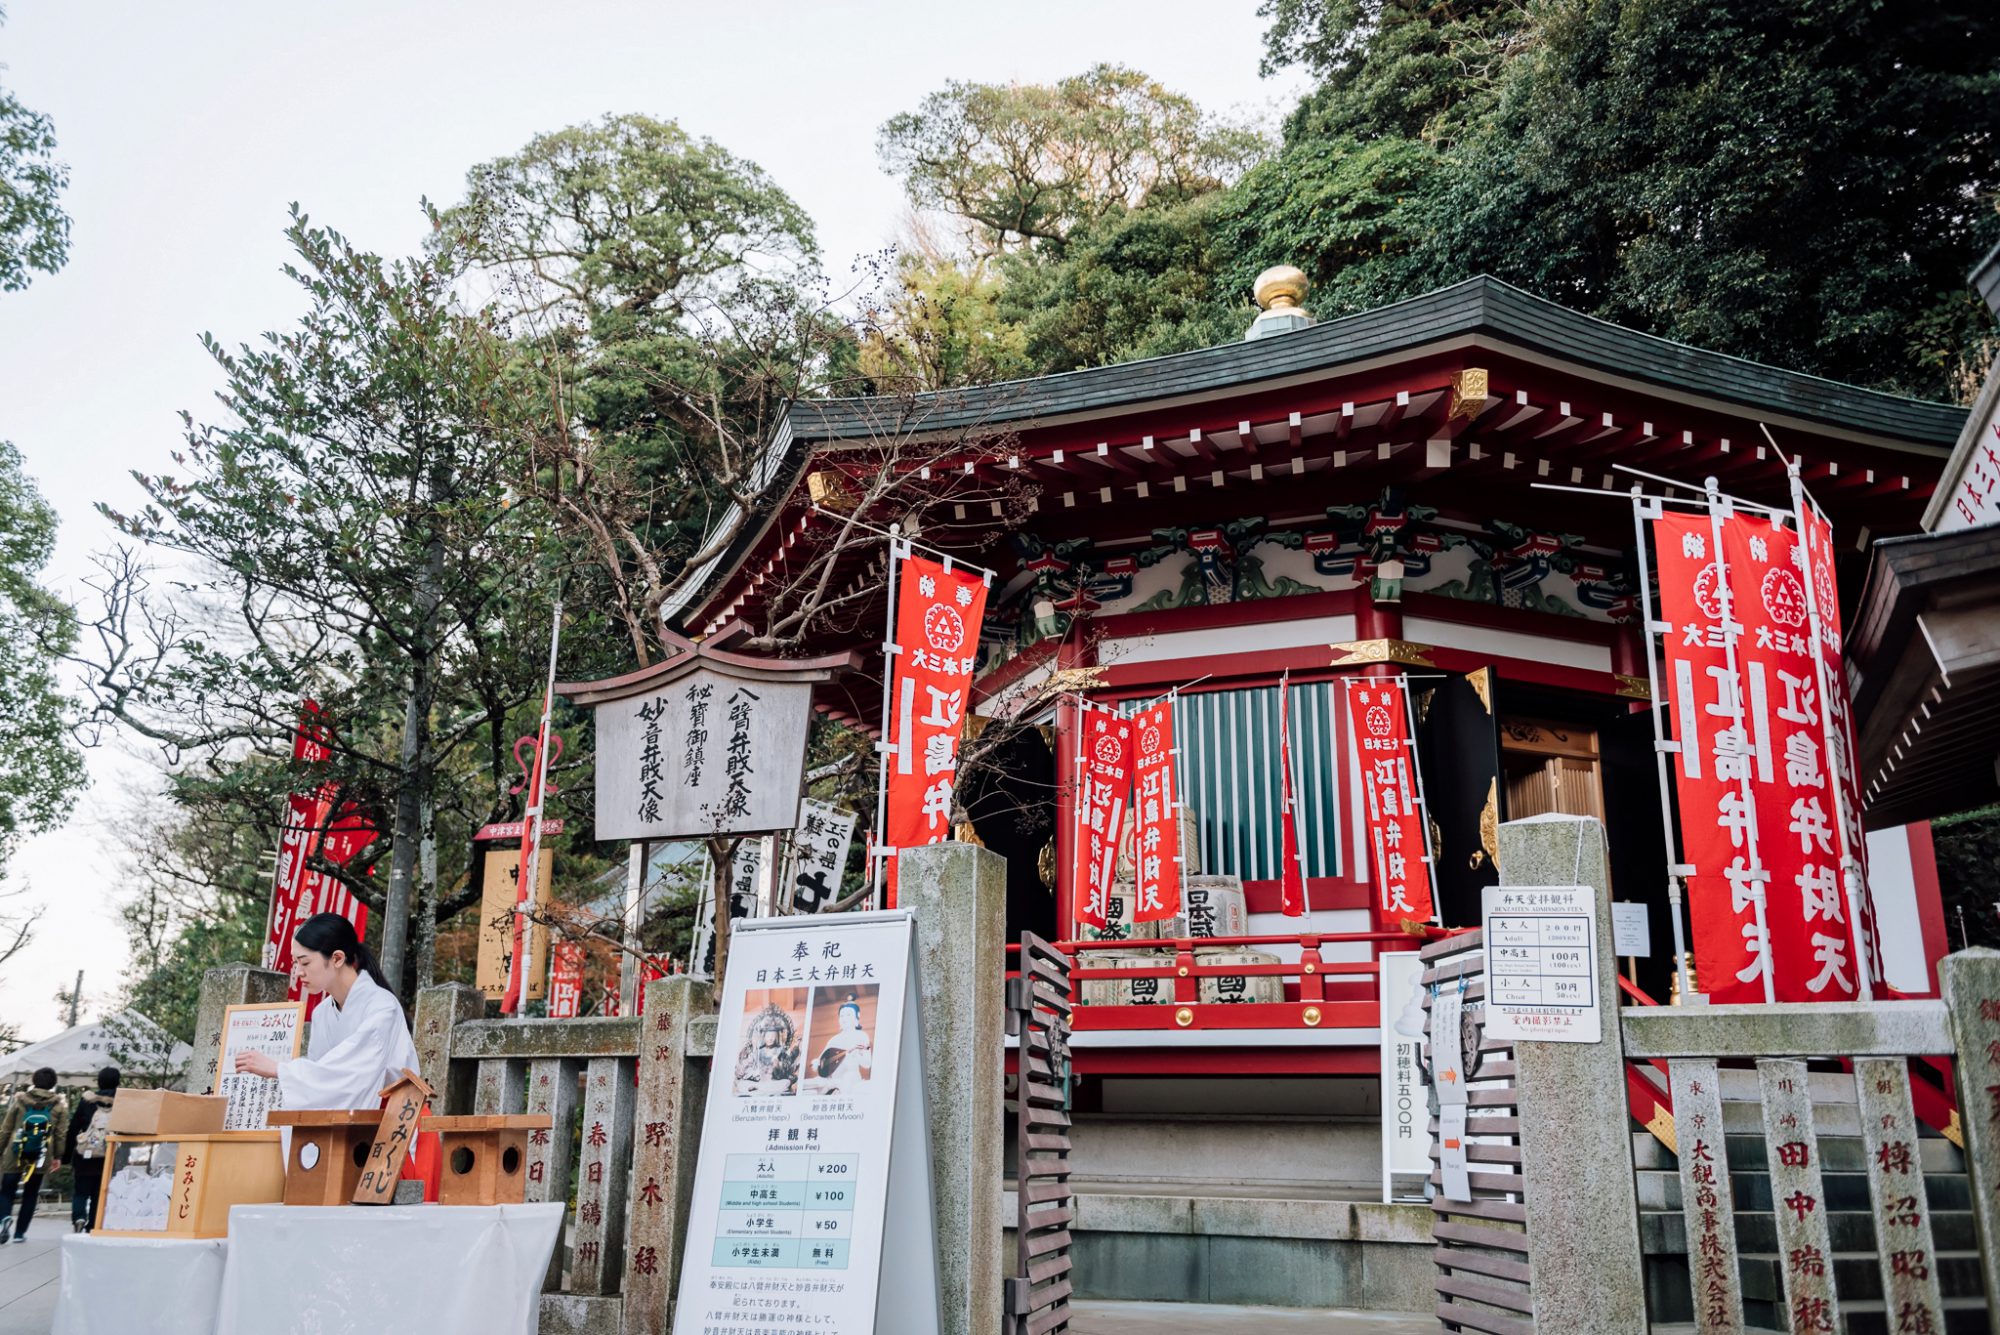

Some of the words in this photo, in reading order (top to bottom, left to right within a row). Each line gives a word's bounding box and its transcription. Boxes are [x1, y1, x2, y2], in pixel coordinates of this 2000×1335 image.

[1363, 737, 1399, 751] 日本三大
[1142, 770, 1164, 913] 江島弁財天
[1374, 757, 1415, 913] 江島弁財天
[1503, 894, 1574, 905] 弁天堂拝観料
[1500, 920, 1528, 929] 大人
[791, 940, 842, 961] 奉祀
[1500, 949, 1529, 958] 中高生
[1551, 953, 1579, 961] 100円
[756, 963, 875, 983] 日本三大弁財天
[1500, 978, 1530, 988] 小人
[1555, 982, 1577, 992] 50円
[261, 1013, 296, 1028] おみくじ
[269, 1031, 286, 1041] 200
[654, 1012, 672, 1062] 藤沢
[812, 1103, 854, 1112] 妙音弁財天
[1689, 1080, 1707, 1130] 東京
[1777, 1079, 1797, 1129] 川崎
[768, 1128, 819, 1141] 拝観料
[375, 1098, 419, 1195] おみくじ
[359, 1141, 386, 1190] 百円
[528, 1128, 551, 1203] 春日
[757, 1163, 775, 1172] 大人
[178, 1154, 198, 1220] おみくじ
[750, 1189, 778, 1199] 中高生
[746, 1218, 774, 1228] 小学生
[1690, 1139, 1731, 1327] 大観商事株式会社
[731, 1247, 780, 1258] 小学生未満
[812, 1248, 834, 1259] 無料
